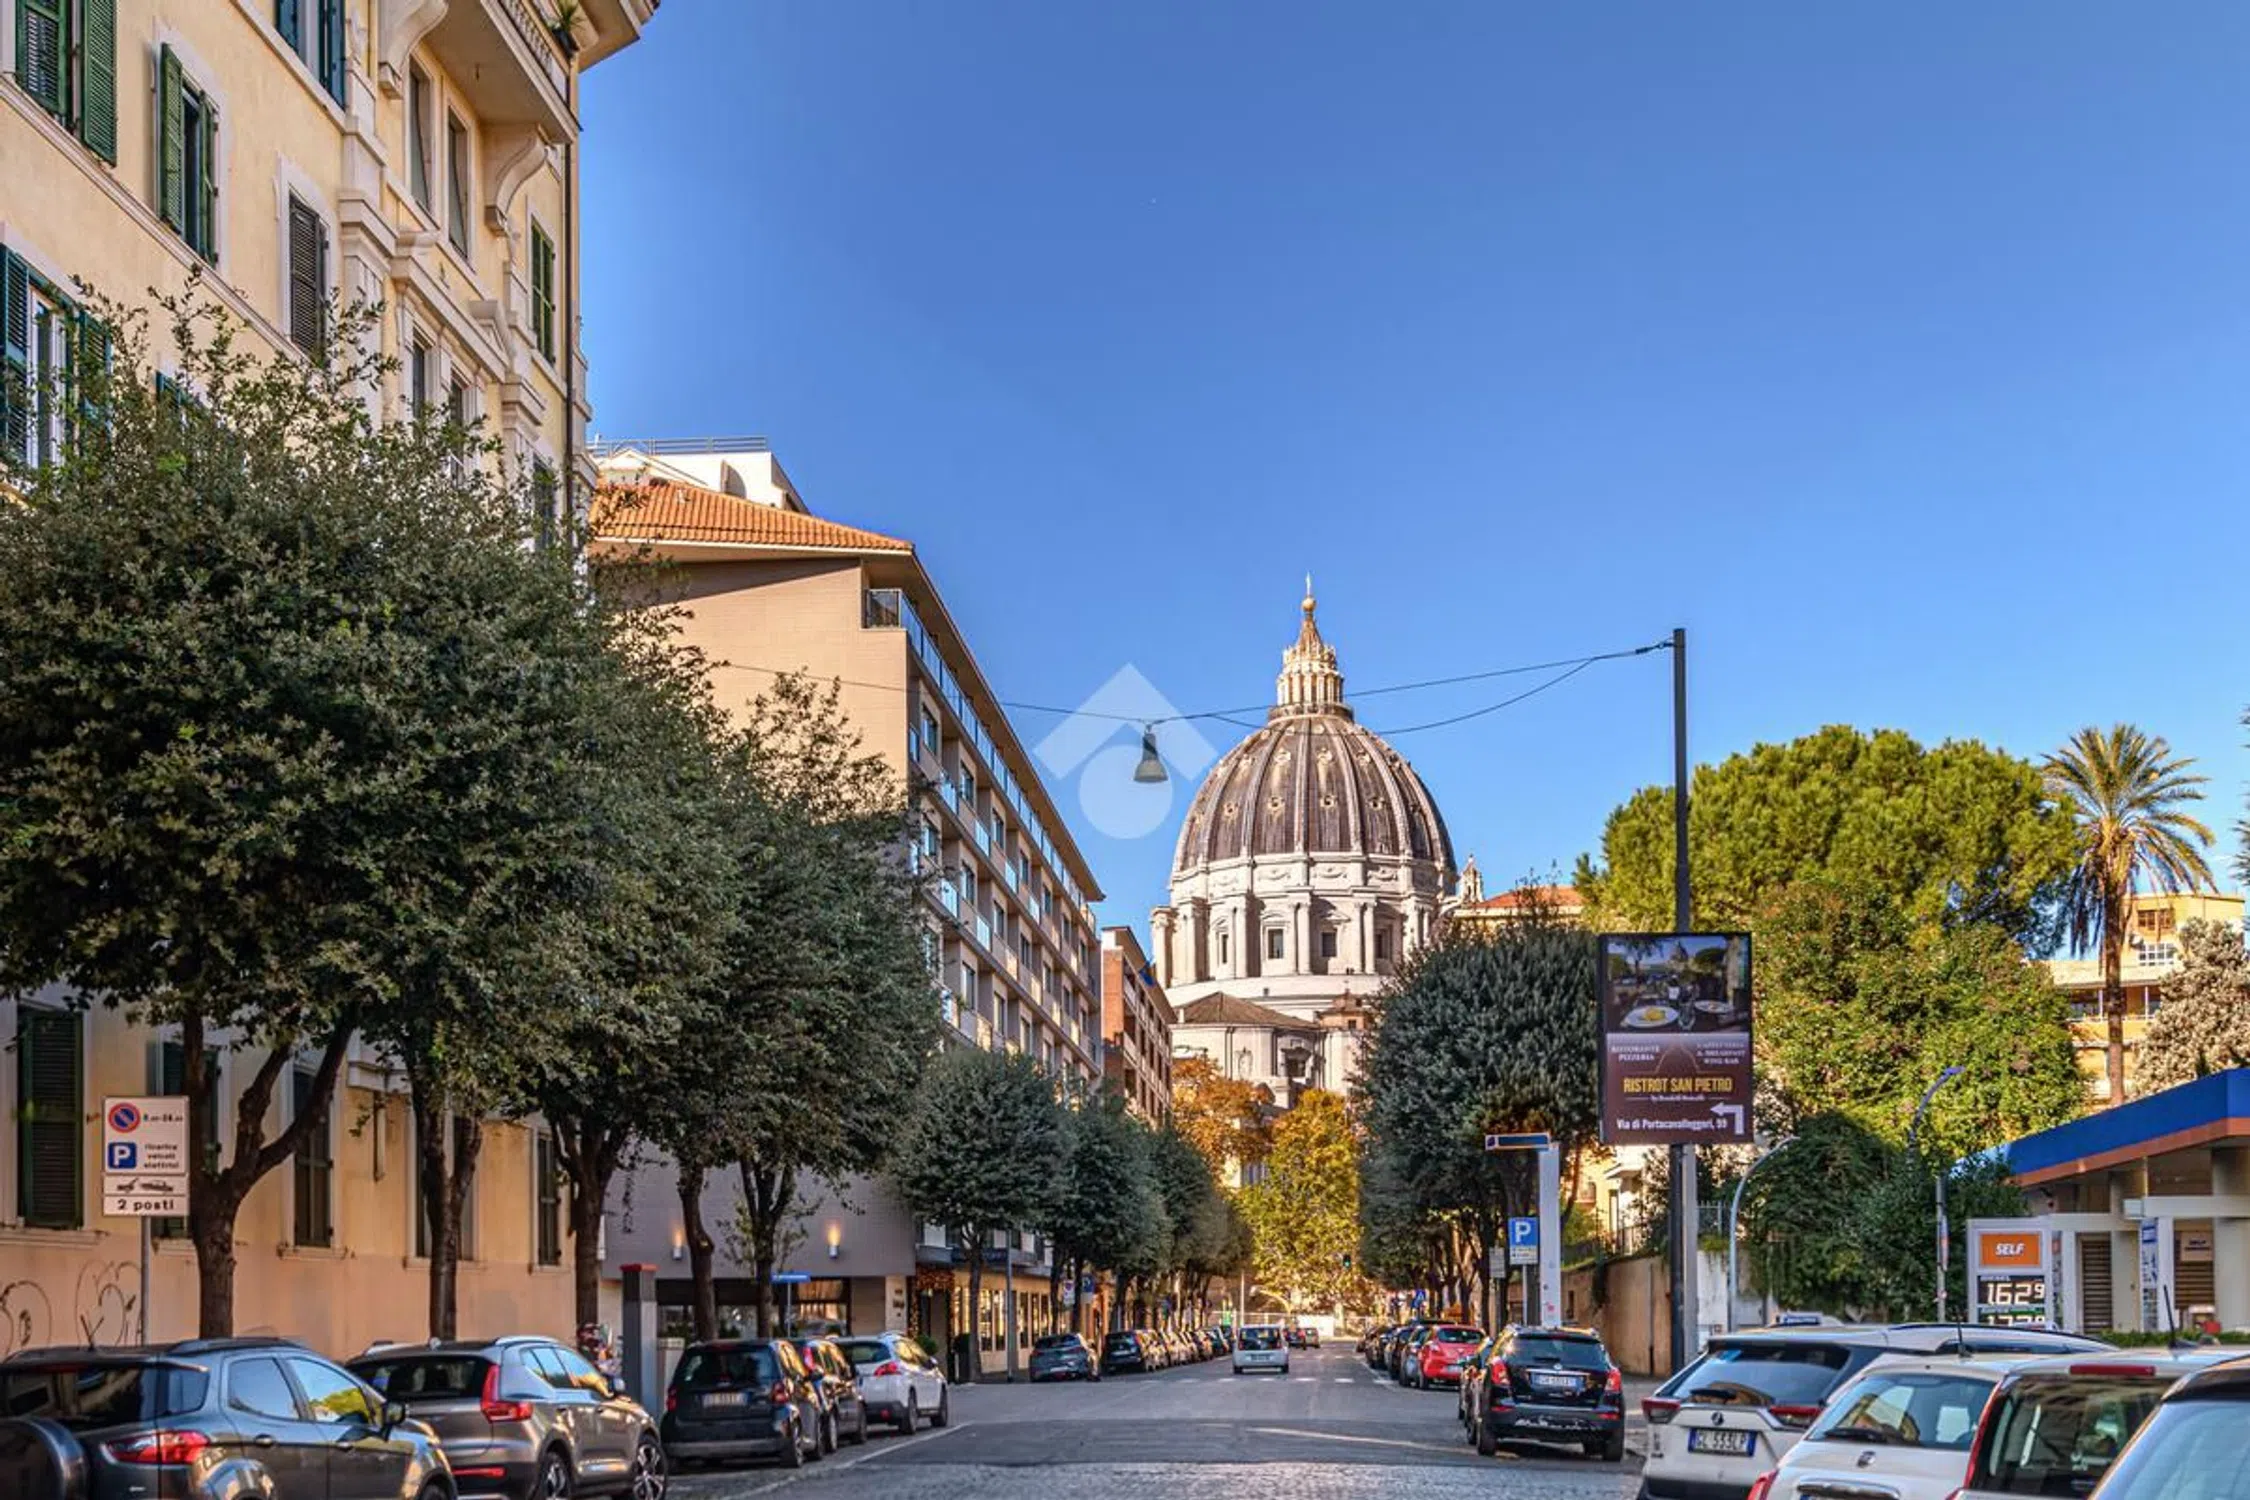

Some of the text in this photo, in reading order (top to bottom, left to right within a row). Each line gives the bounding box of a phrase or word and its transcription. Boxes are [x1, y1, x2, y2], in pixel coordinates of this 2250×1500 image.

[1670, 1078, 1693, 1093] SAN
[1695, 1078, 1733, 1093] PIETRO
[1617, 1119, 1630, 1129] Via
[1632, 1119, 1640, 1129] di
[114, 1145, 131, 1166] P
[118, 1199, 174, 1212] 2 posti
[1515, 1221, 1531, 1243] P
[1995, 1243, 2025, 1255] SELF
